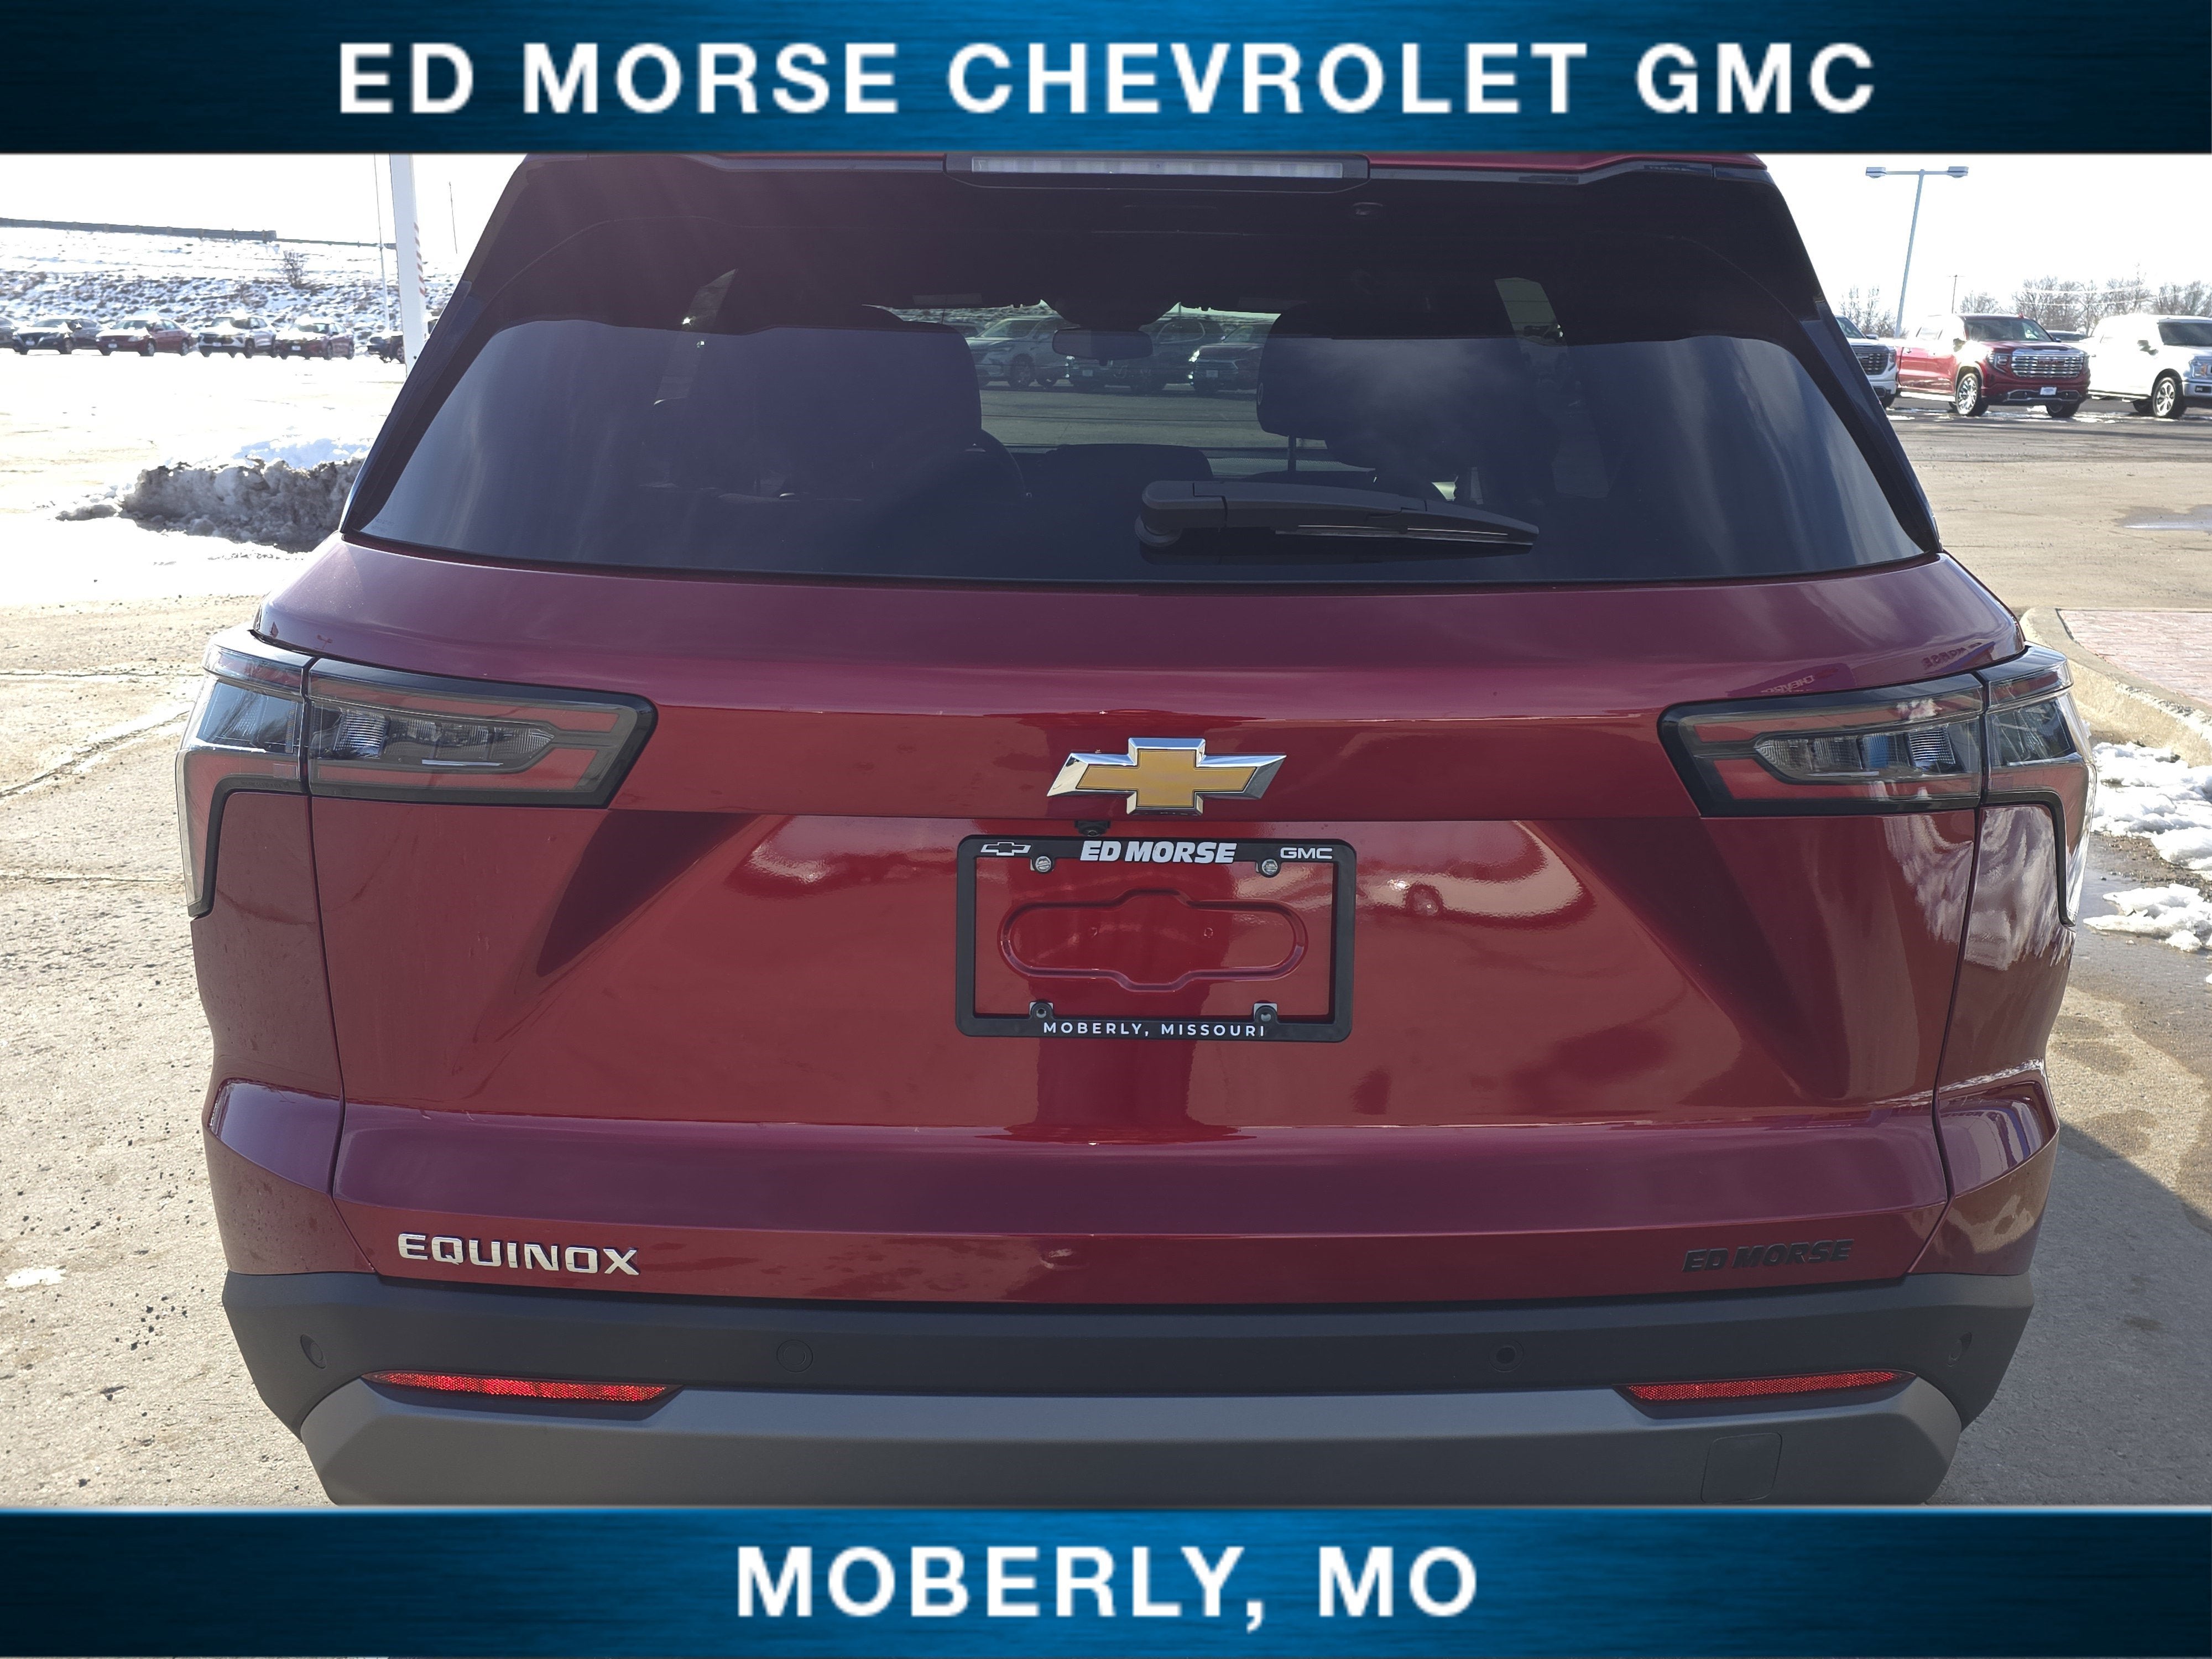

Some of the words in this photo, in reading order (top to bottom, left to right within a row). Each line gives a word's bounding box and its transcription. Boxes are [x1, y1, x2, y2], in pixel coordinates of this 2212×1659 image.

[1080, 841, 1120, 862] ED
[1124, 841, 1237, 864] MORSE
[1280, 847, 1333, 860] GMC
[1043, 1021, 1150, 1037] MOBERLY,
[1161, 1024, 1265, 1038] MISSOURI
[398, 1233, 639, 1276] EQUINOX
[1682, 1248, 1729, 1272] ED
[1732, 1238, 1855, 1269] MORSE
